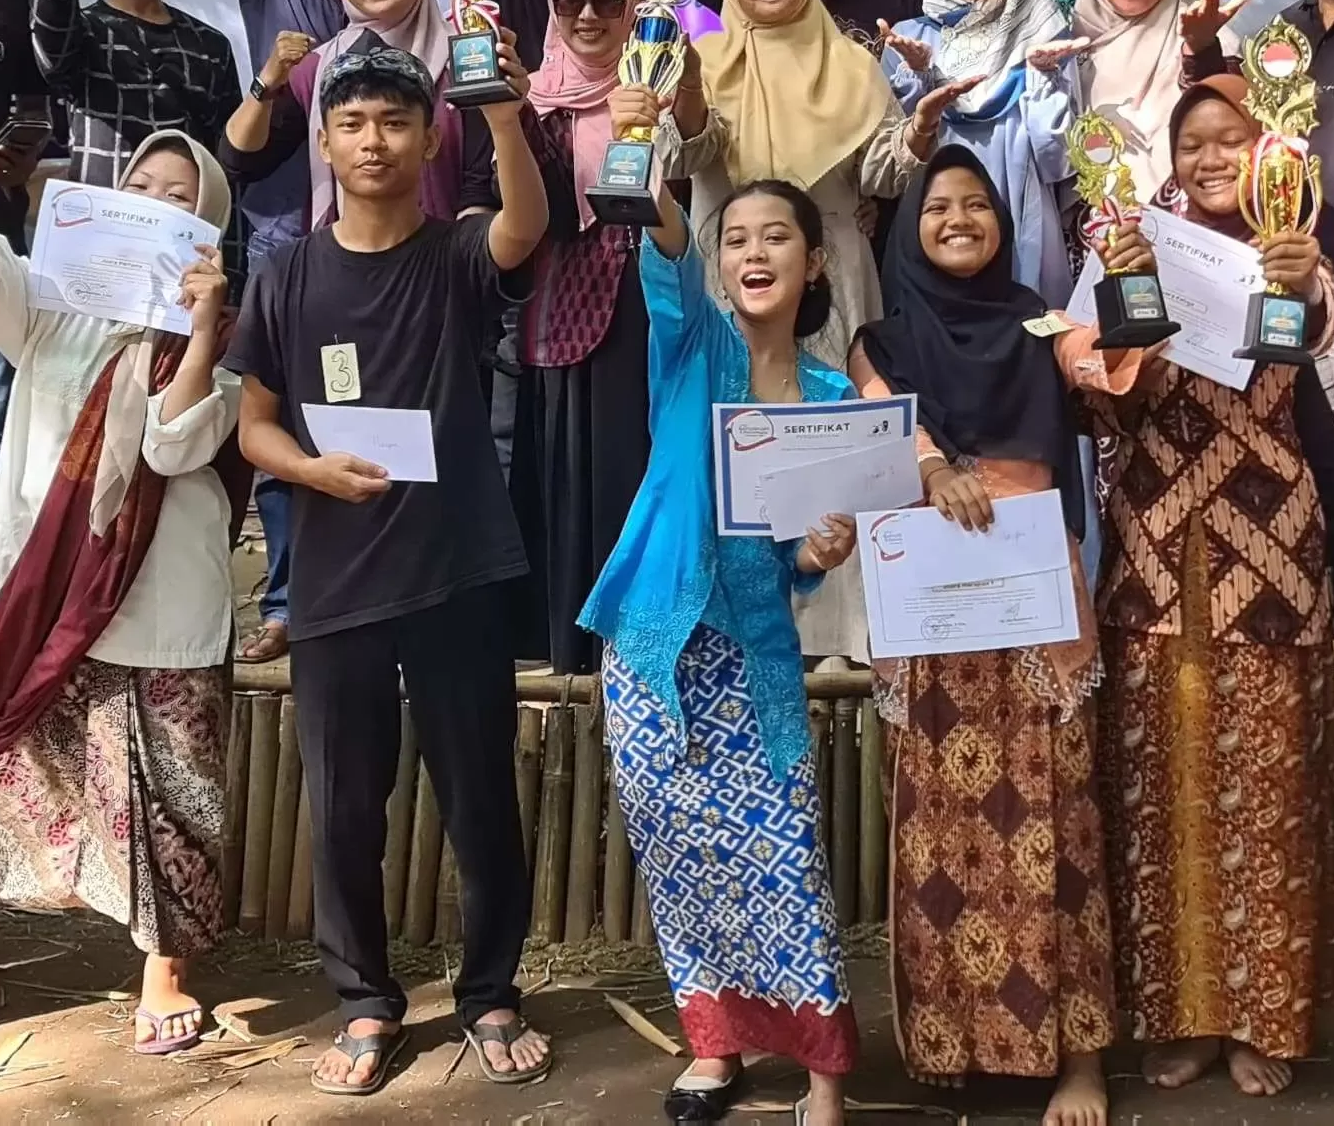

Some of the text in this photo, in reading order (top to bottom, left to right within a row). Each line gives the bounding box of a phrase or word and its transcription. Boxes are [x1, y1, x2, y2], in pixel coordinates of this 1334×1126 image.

[99, 209, 162, 226] SERTIFIKAT
[1164, 237, 1224, 267] SERTIFIKAT
[330, 349, 355, 393] 3
[784, 422, 851, 434] SERTIFIKAT
